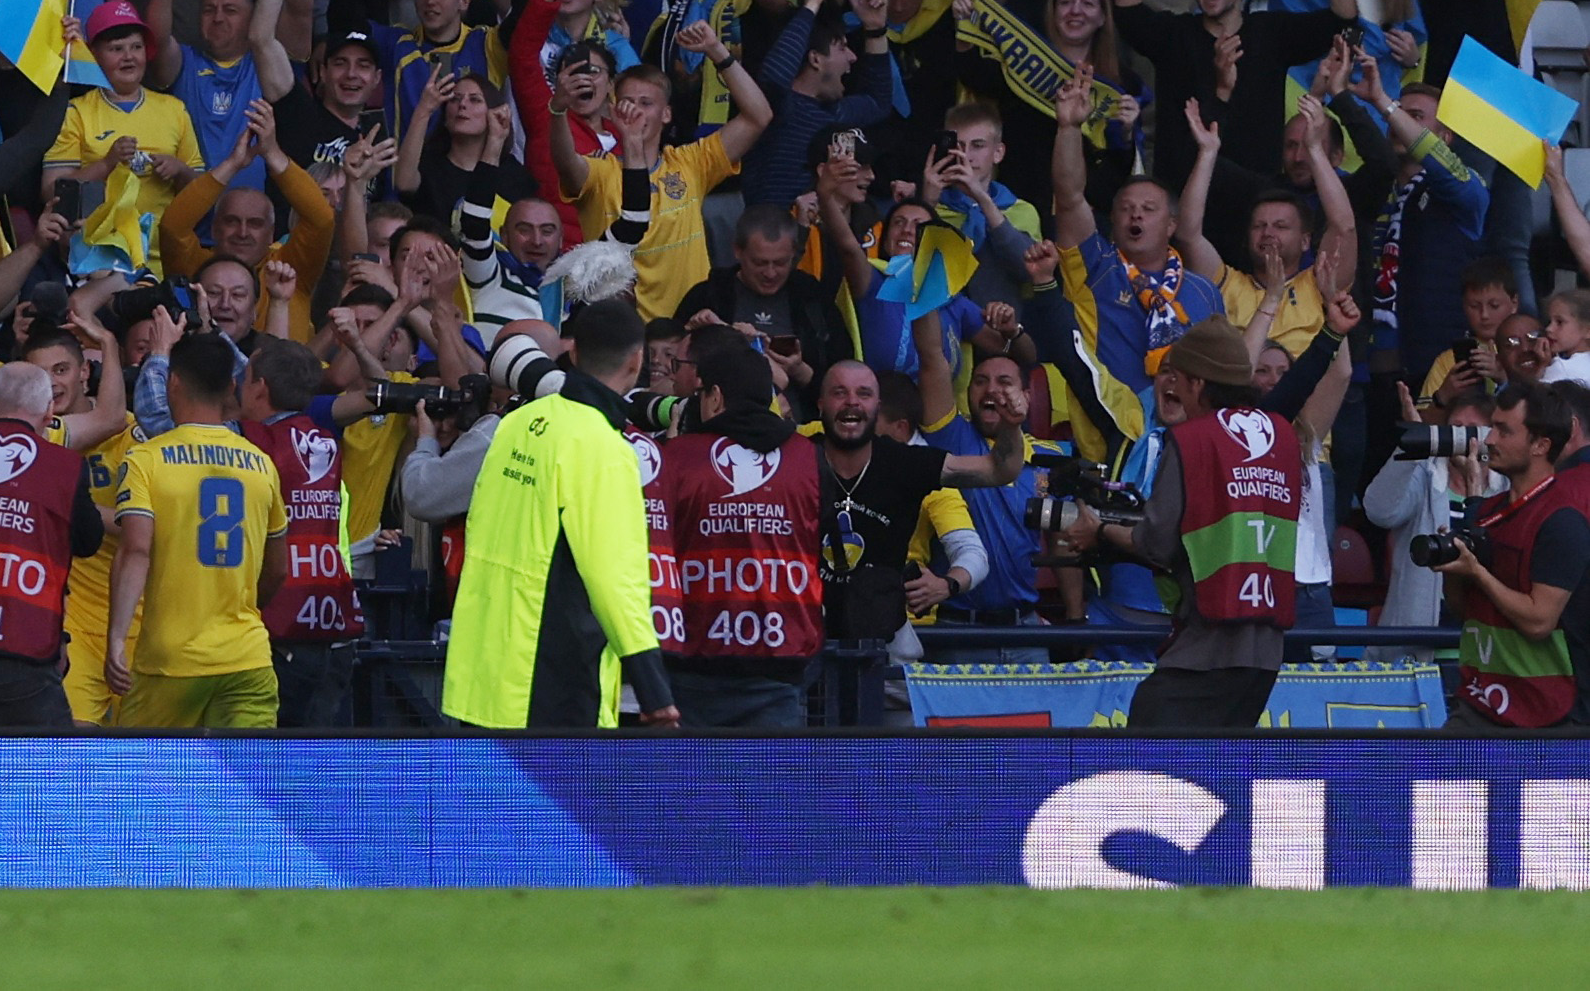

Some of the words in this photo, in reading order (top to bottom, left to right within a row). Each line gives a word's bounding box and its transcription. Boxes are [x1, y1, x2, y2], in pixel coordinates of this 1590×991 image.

[979, 11, 1066, 103] UKRAIN
[161, 444, 269, 475] MALINOVSKYI
[708, 502, 784, 518] EUROPEAN
[1226, 481, 1292, 504] QUALFIERS
[196, 476, 245, 568] 8
[699, 518, 794, 536] QUALIFIERS
[682, 557, 808, 596] PHOTO
[650, 605, 686, 643] 08
[708, 610, 786, 648] 408
